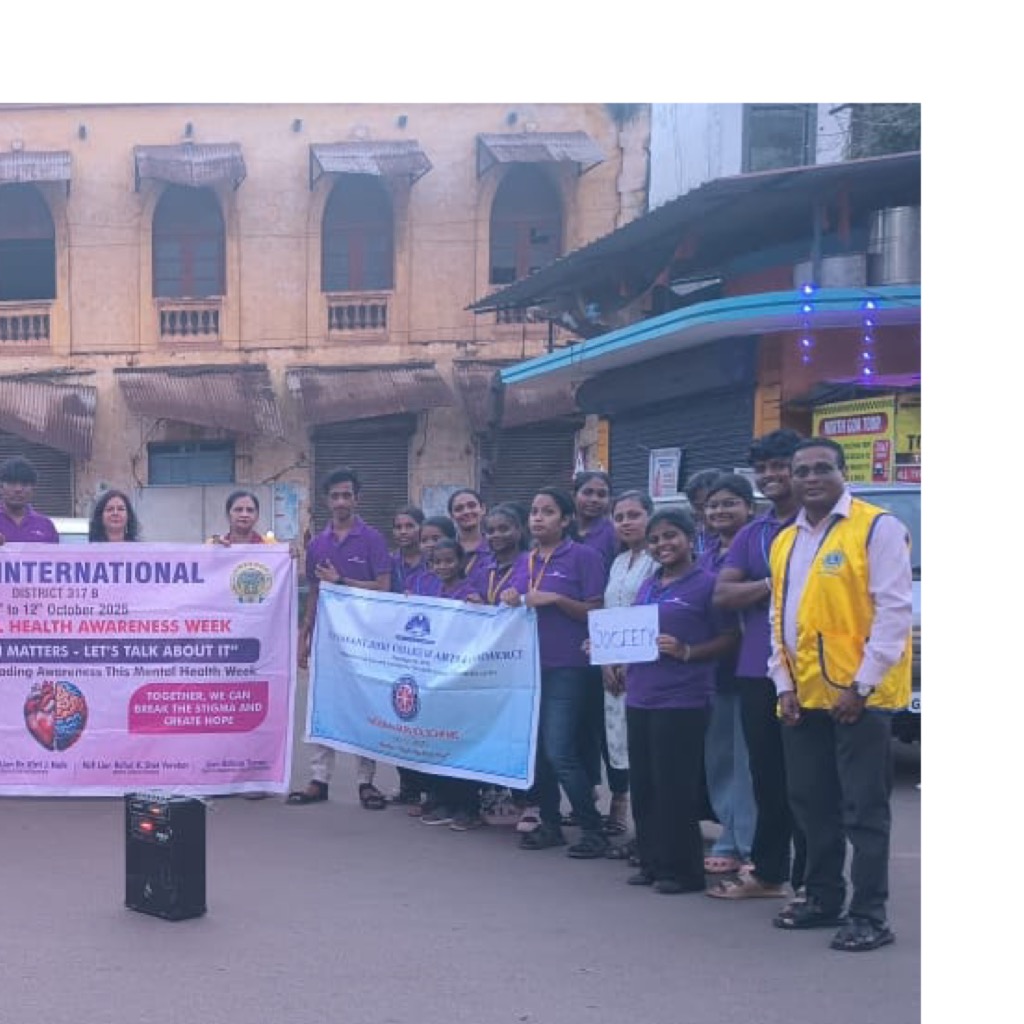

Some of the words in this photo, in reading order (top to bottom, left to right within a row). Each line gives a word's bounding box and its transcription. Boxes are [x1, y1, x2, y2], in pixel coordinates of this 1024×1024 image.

[12, 587, 62, 599] DISTRICT
[67, 587, 88, 599] 317
[7, 604, 19, 616] to
[47, 603, 94, 616] October
[99, 603, 128, 616] 2025
[9, 620, 73, 635] HEALTH
[78, 619, 179, 634] AWARENESS
[184, 619, 231, 633] WEEK
[6, 645, 69, 658] MATTERS
[84, 645, 118, 658] LET'S
[124, 645, 157, 658] TALK
[163, 644, 214, 657] ABOUT
[36, 665, 102, 678] Awareness
[105, 666, 130, 677] This
[133, 666, 175, 677] Mental
[179, 665, 221, 677] Health
[209, 691, 226, 701] WE
[230, 690, 251, 701] CAN
[134, 703, 169, 714] BREAK
[173, 703, 192, 713] THE
[195, 703, 236, 713] STIGMA
[239, 702, 262, 713] AND
[163, 716, 201, 727] CREATE
[204, 716, 234, 726] HOPE
